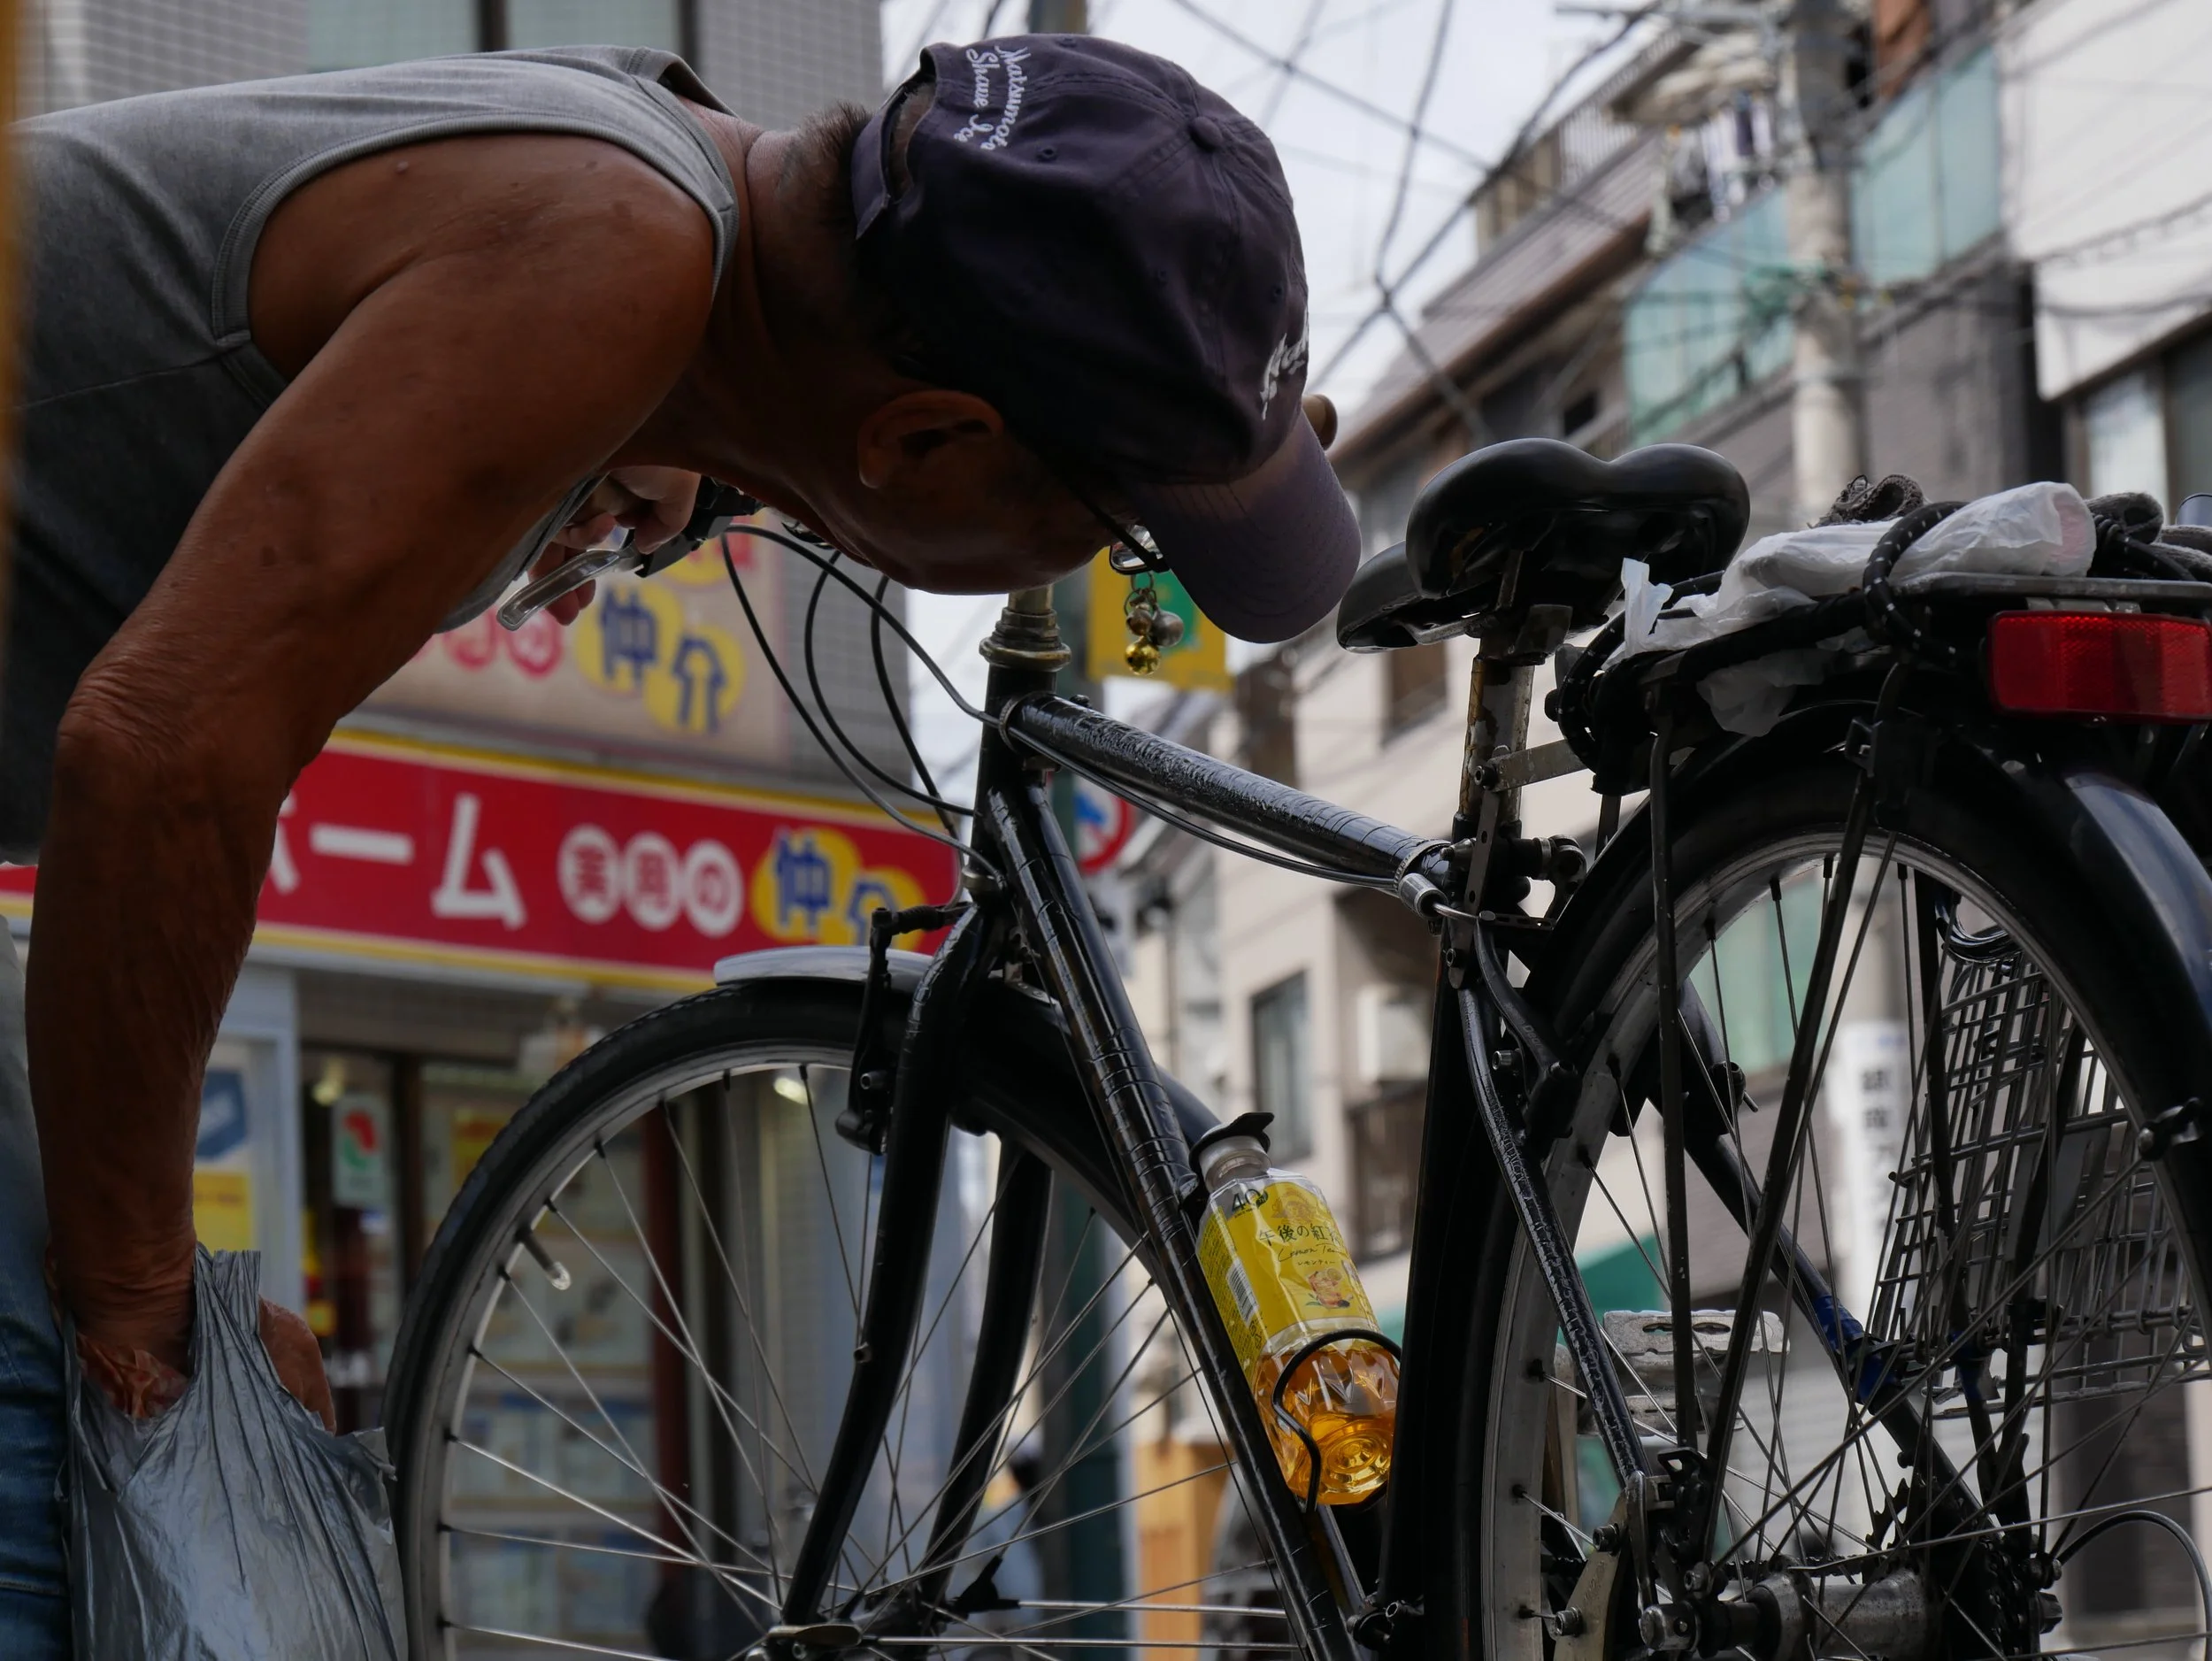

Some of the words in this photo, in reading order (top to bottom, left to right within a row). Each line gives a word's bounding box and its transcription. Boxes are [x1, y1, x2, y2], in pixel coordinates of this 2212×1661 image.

[965, 48, 1001, 108] Shave
[1258, 1221, 1341, 1247] 午後の紅
[1278, 1248, 1318, 1263] Lemon
